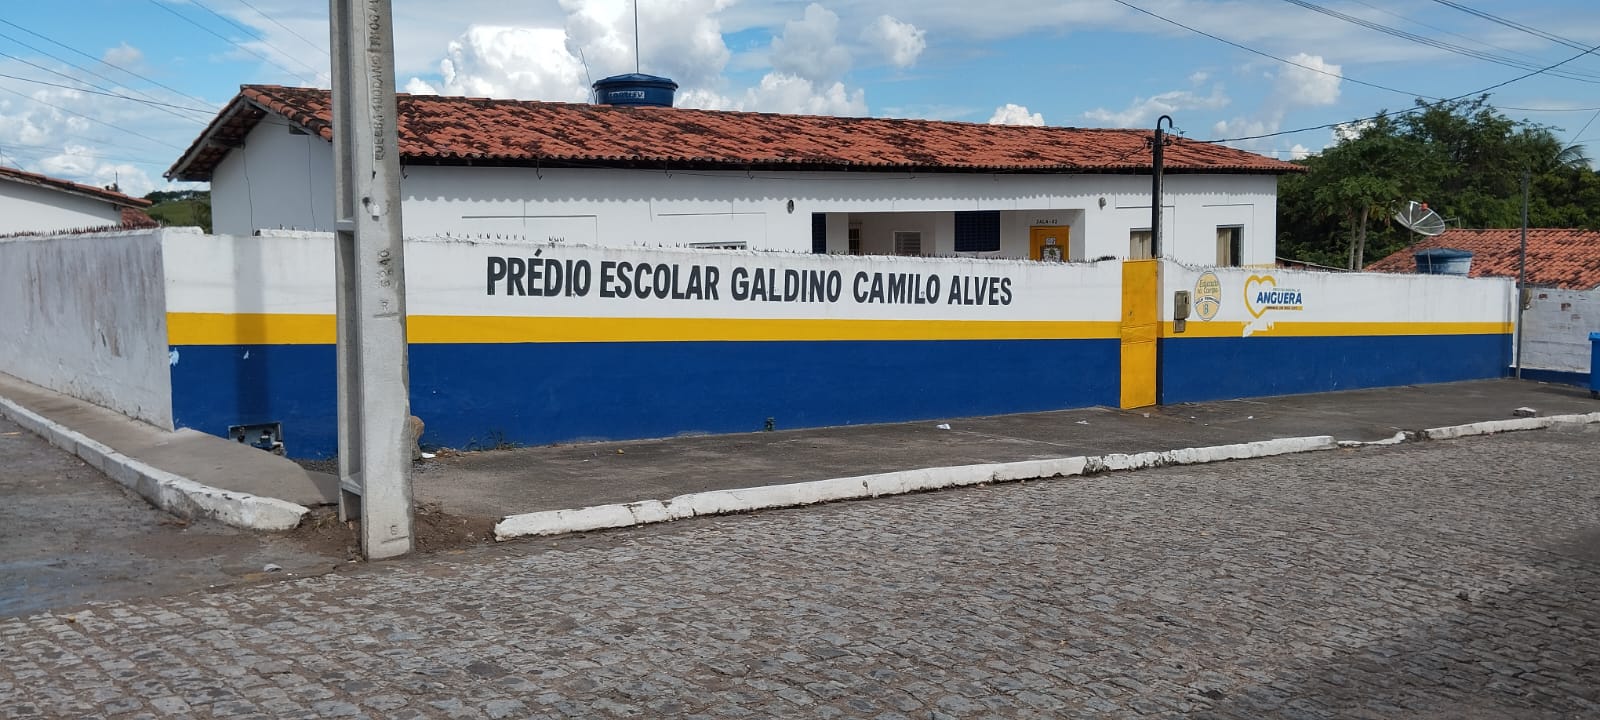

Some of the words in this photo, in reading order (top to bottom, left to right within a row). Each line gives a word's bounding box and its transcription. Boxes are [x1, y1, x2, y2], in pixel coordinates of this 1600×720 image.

[486, 248, 592, 297] PRÉDIO
[599, 261, 720, 301] ESCOLAR
[730, 266, 842, 303] GALDINO
[852, 271, 941, 305] CAMILO
[947, 275, 1013, 306] ALVES
[1256, 291, 1303, 305] ANGUERA
